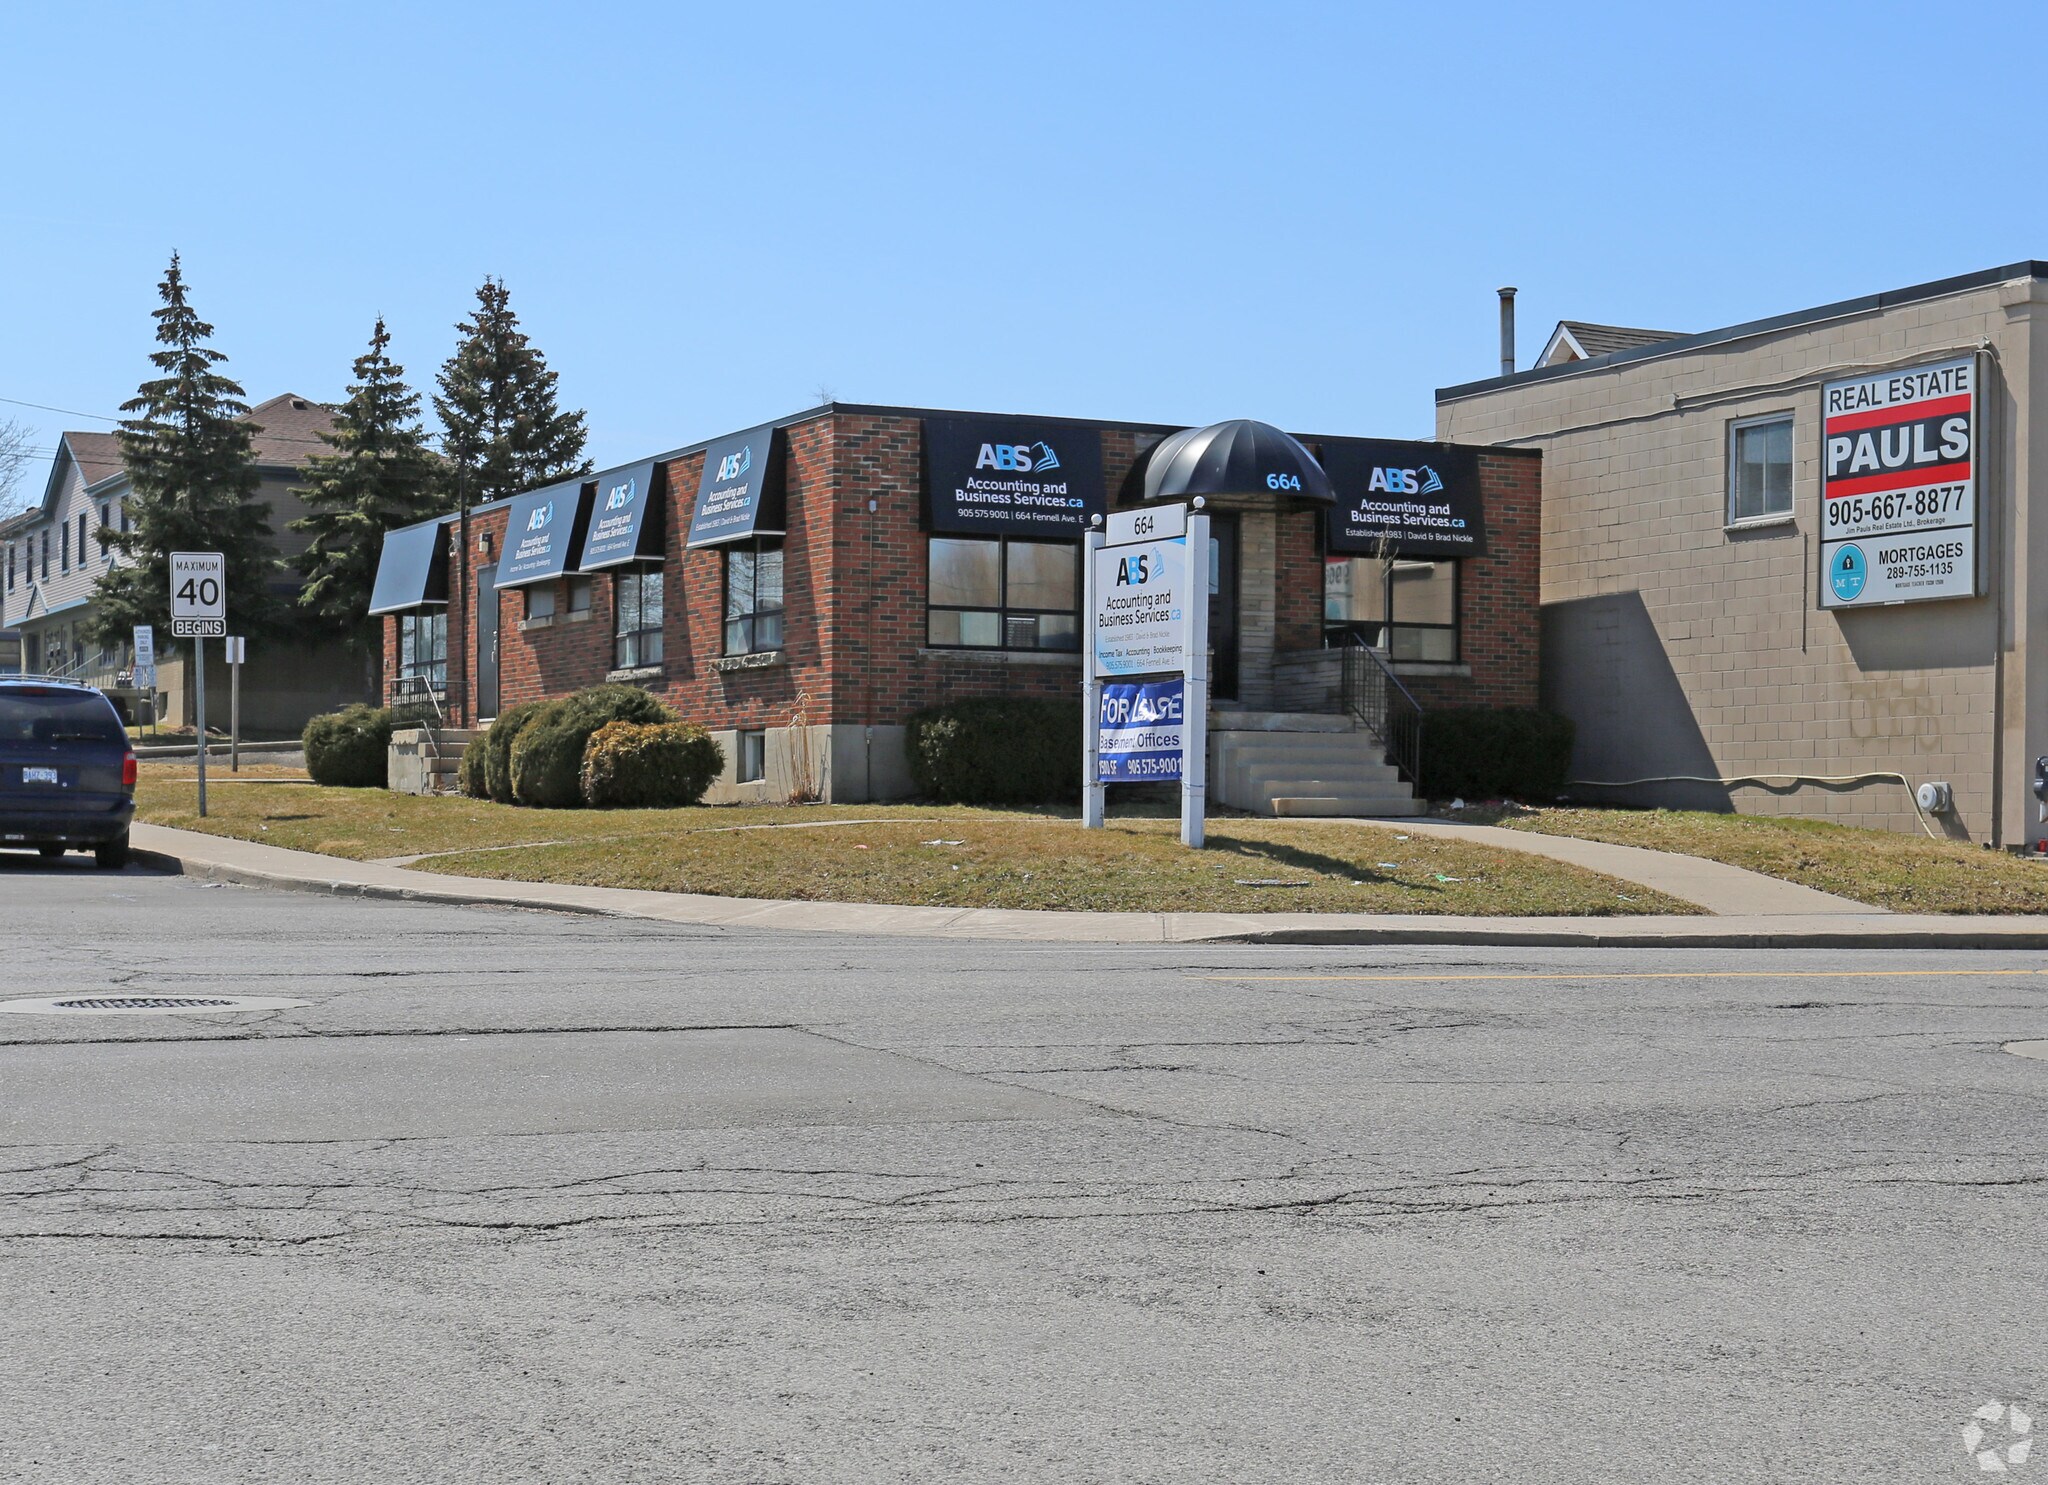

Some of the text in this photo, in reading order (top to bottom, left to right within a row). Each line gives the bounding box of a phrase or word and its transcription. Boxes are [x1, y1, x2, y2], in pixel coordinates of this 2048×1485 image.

[1829, 366, 1968, 412] REAL ESTATE
[1827, 417, 1969, 476] PAULS
[715, 452, 742, 482] ABS
[975, 443, 1033, 473] ABS
[966, 476, 1067, 496] Accounting and
[1266, 473, 1301, 491] 664
[1368, 467, 1419, 494] ABS
[605, 484, 628, 511] ABS
[708, 482, 748, 503] Accounting and
[955, 488, 1084, 508] Business Services.ca
[701, 502, 722, 516] Business
[1360, 498, 1450, 516] Accounting and
[1829, 485, 1965, 526] 905-667-8877
[527, 506, 547, 531] ABS
[598, 512, 632, 529] Accounting and
[957, 508, 974, 517] 905
[974, 509, 989, 518] 575
[989, 510, 1010, 519] 9001
[1015, 511, 1031, 520] 664
[1032, 512, 1060, 522] Fennell
[1078, 515, 1084, 523] E
[1350, 510, 1465, 528] Business Services.ca
[1134, 516, 1154, 535] 664
[1856, 525, 1871, 533] Pauls
[1885, 521, 1902, 529] Estate
[1917, 517, 1946, 526] Brokerage
[592, 529, 609, 542] Business
[1345, 528, 1383, 538] Established
[1407, 531, 1427, 540] David
[1435, 533, 1451, 542] Brad
[1452, 534, 1473, 543] Nickle
[1879, 542, 1963, 565] MORTGAGES
[176, 561, 218, 571] MAXIMUM
[1116, 554, 1148, 586] ABS
[1887, 562, 1953, 579] 289-755-1135
[1835, 577, 1861, 588] M T
[176, 578, 219, 606] 40
[1106, 590, 1171, 610] Accounting and
[176, 621, 222, 634] BEGINS
[1099, 611, 1133, 628] Business
[1099, 650, 1114, 658] Income
[1126, 648, 1150, 657] Accounting
[1153, 645, 1182, 654] Bookkeeping
[1101, 693, 1130, 723] FOR
[1137, 733, 1180, 747] Offices
[1127, 759, 1140, 775] 905
[1142, 757, 1182, 774] 575-9001
